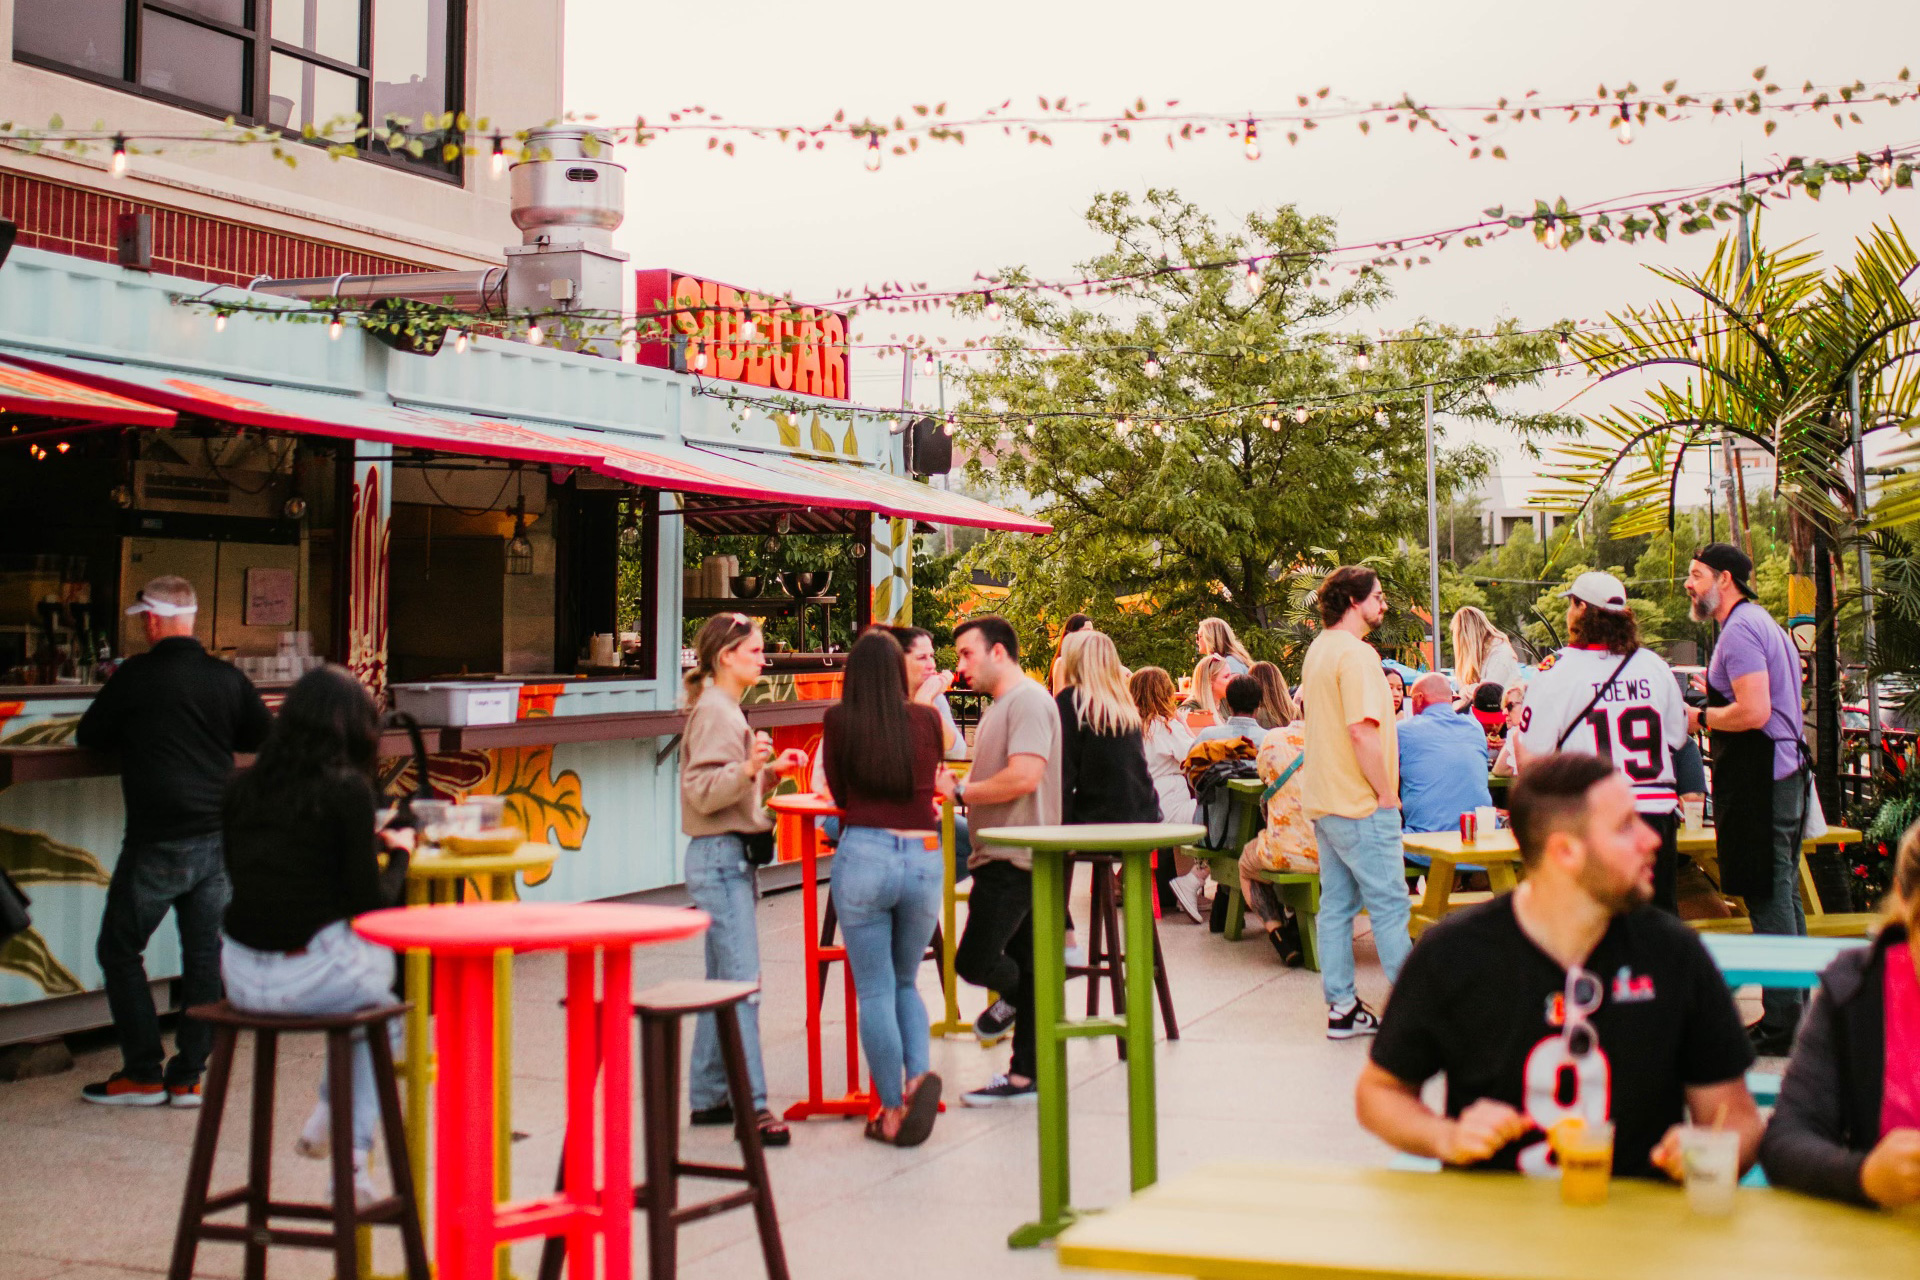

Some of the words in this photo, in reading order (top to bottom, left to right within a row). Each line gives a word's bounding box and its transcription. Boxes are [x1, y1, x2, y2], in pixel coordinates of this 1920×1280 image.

[672, 276, 845, 400] SIDECAR
[1592, 679, 1651, 702] TOEWS
[1586, 705, 1663, 782] 19
